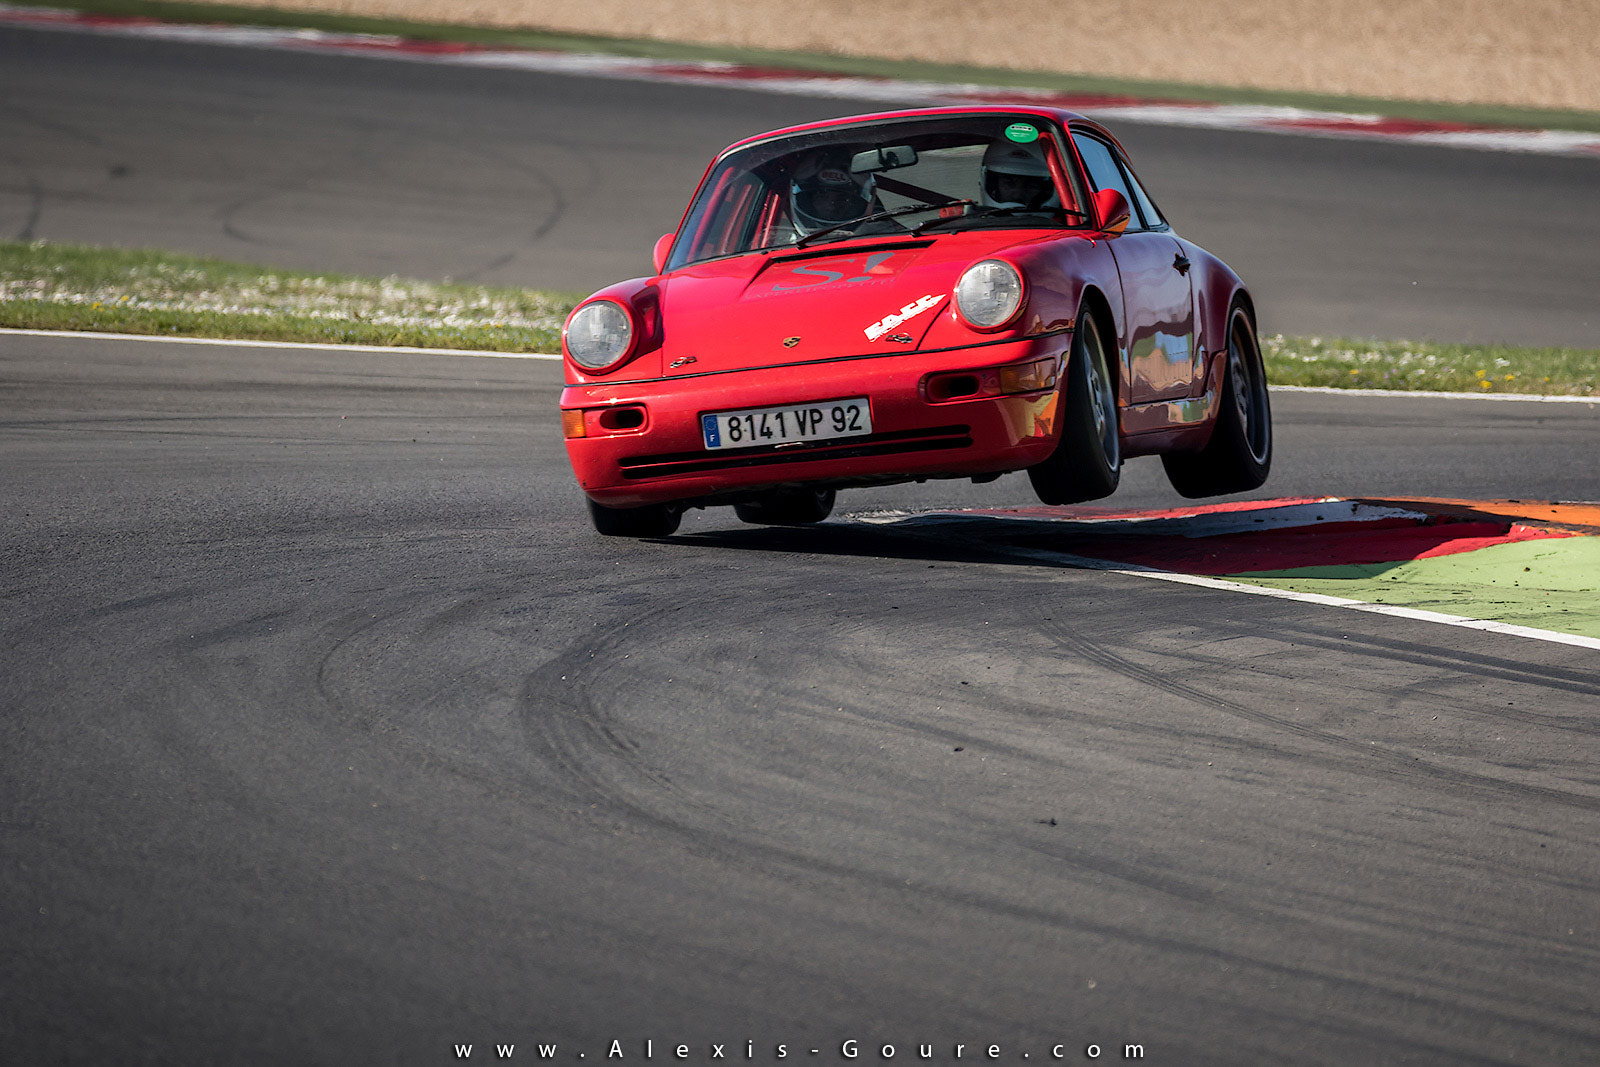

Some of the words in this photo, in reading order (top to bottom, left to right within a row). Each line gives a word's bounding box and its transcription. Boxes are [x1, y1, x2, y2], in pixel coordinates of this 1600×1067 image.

[772, 252, 895, 291] S!
[709, 434, 716, 442] F
[728, 412, 786, 442] 8141
[794, 408, 823, 436] VP
[831, 404, 863, 432] 92
